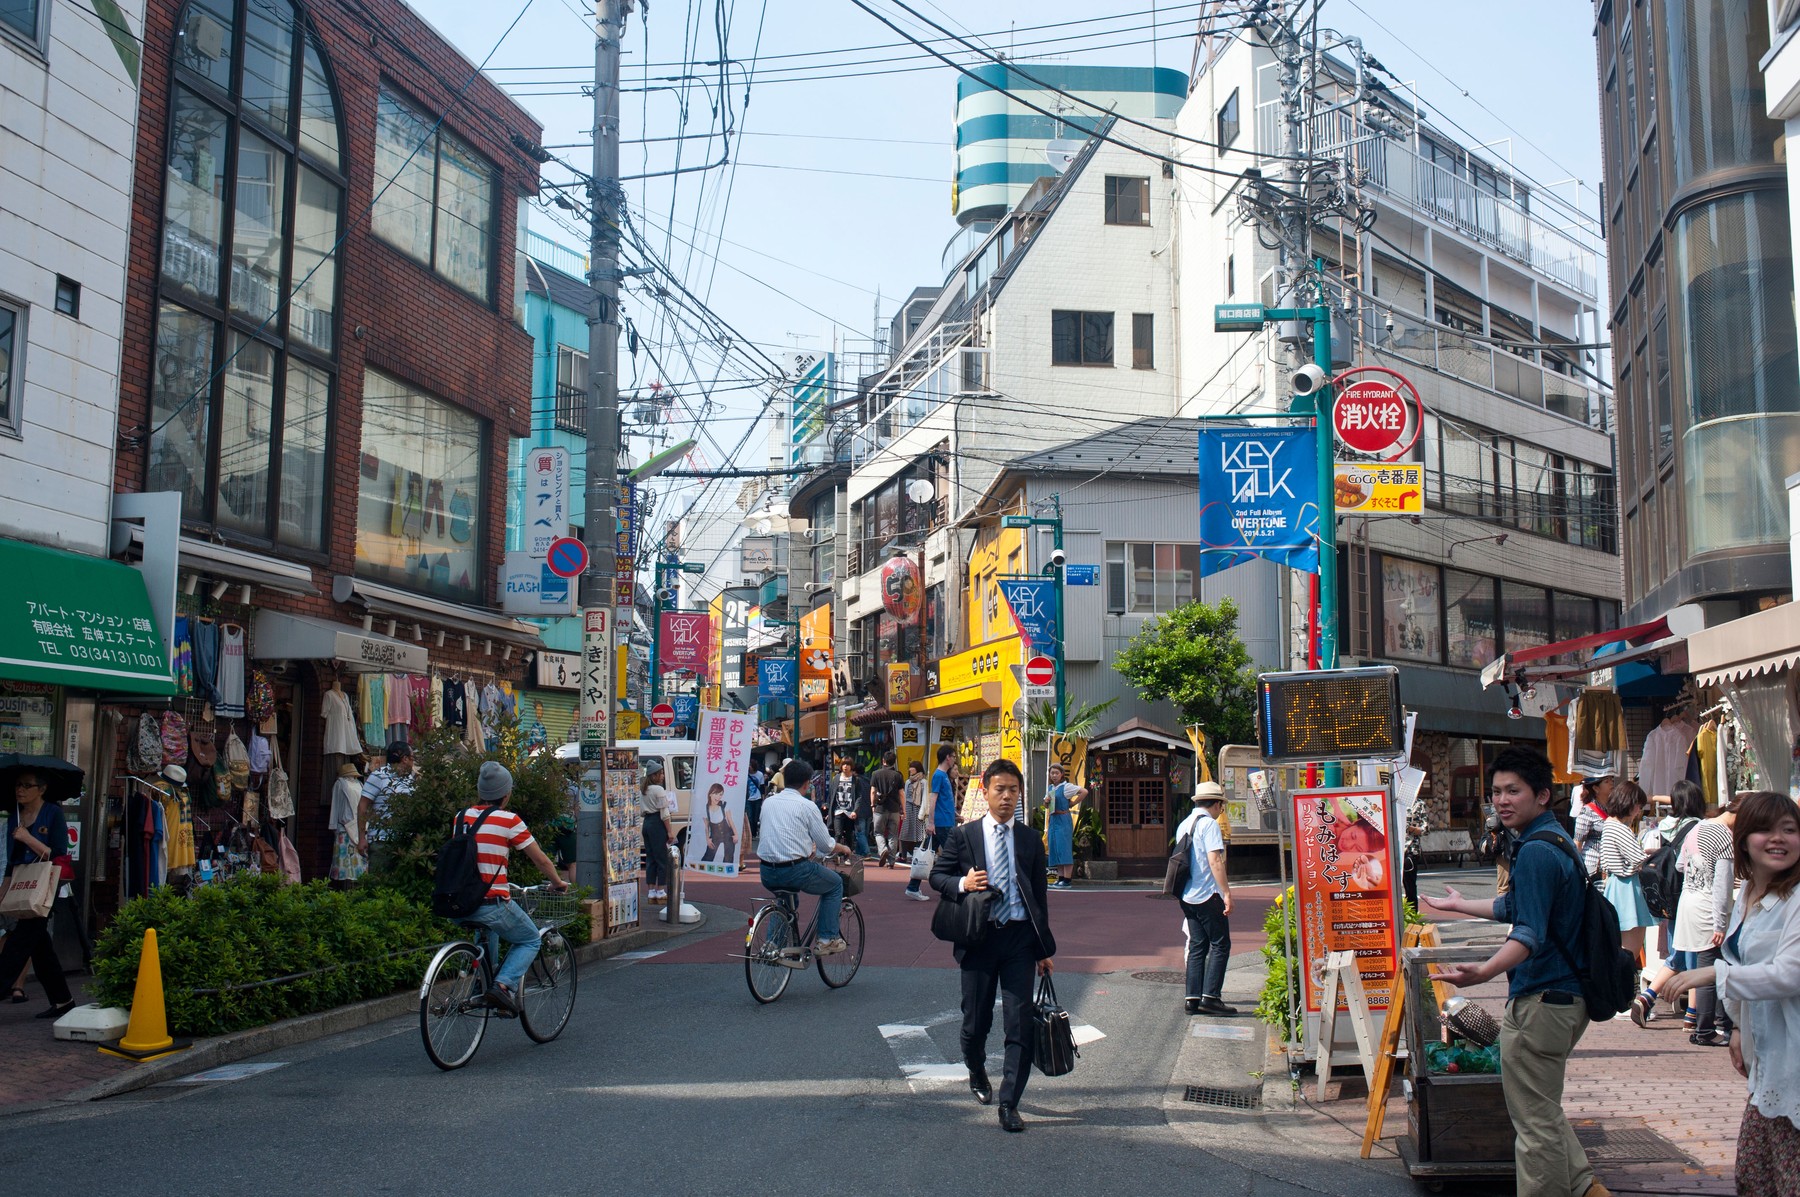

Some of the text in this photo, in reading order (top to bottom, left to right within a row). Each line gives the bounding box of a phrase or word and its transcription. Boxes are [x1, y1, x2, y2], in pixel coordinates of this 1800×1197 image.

[1219, 309, 1260, 318] 南口商店街
[1341, 403, 1401, 430] 消火栓
[1221, 440, 1285, 472] KEY
[1225, 468, 1296, 504] TALK
[1372, 498, 1398, 508] すぐそこ
[1231, 517, 1287, 529] OVERTONE
[507, 582, 540, 592] FLASH
[1008, 586, 1040, 602] KEY
[1010, 601, 1046, 619] TALK
[32, 619, 76, 639] 有限会社
[670, 617, 698, 631] KEY
[672, 629, 701, 645] TALK
[38, 640, 163, 668] TEL 03(3413)1001
[586, 645, 603, 705] きくや
[765, 663, 786, 673] KEY
[766, 671, 789, 683] TALK
[707, 717, 726, 774] 部屋探し
[723, 719, 744, 788] おしゃれな
[1303, 804, 1318, 891] リラクゼーション
[1316, 801, 1353, 892] もみほぐす
